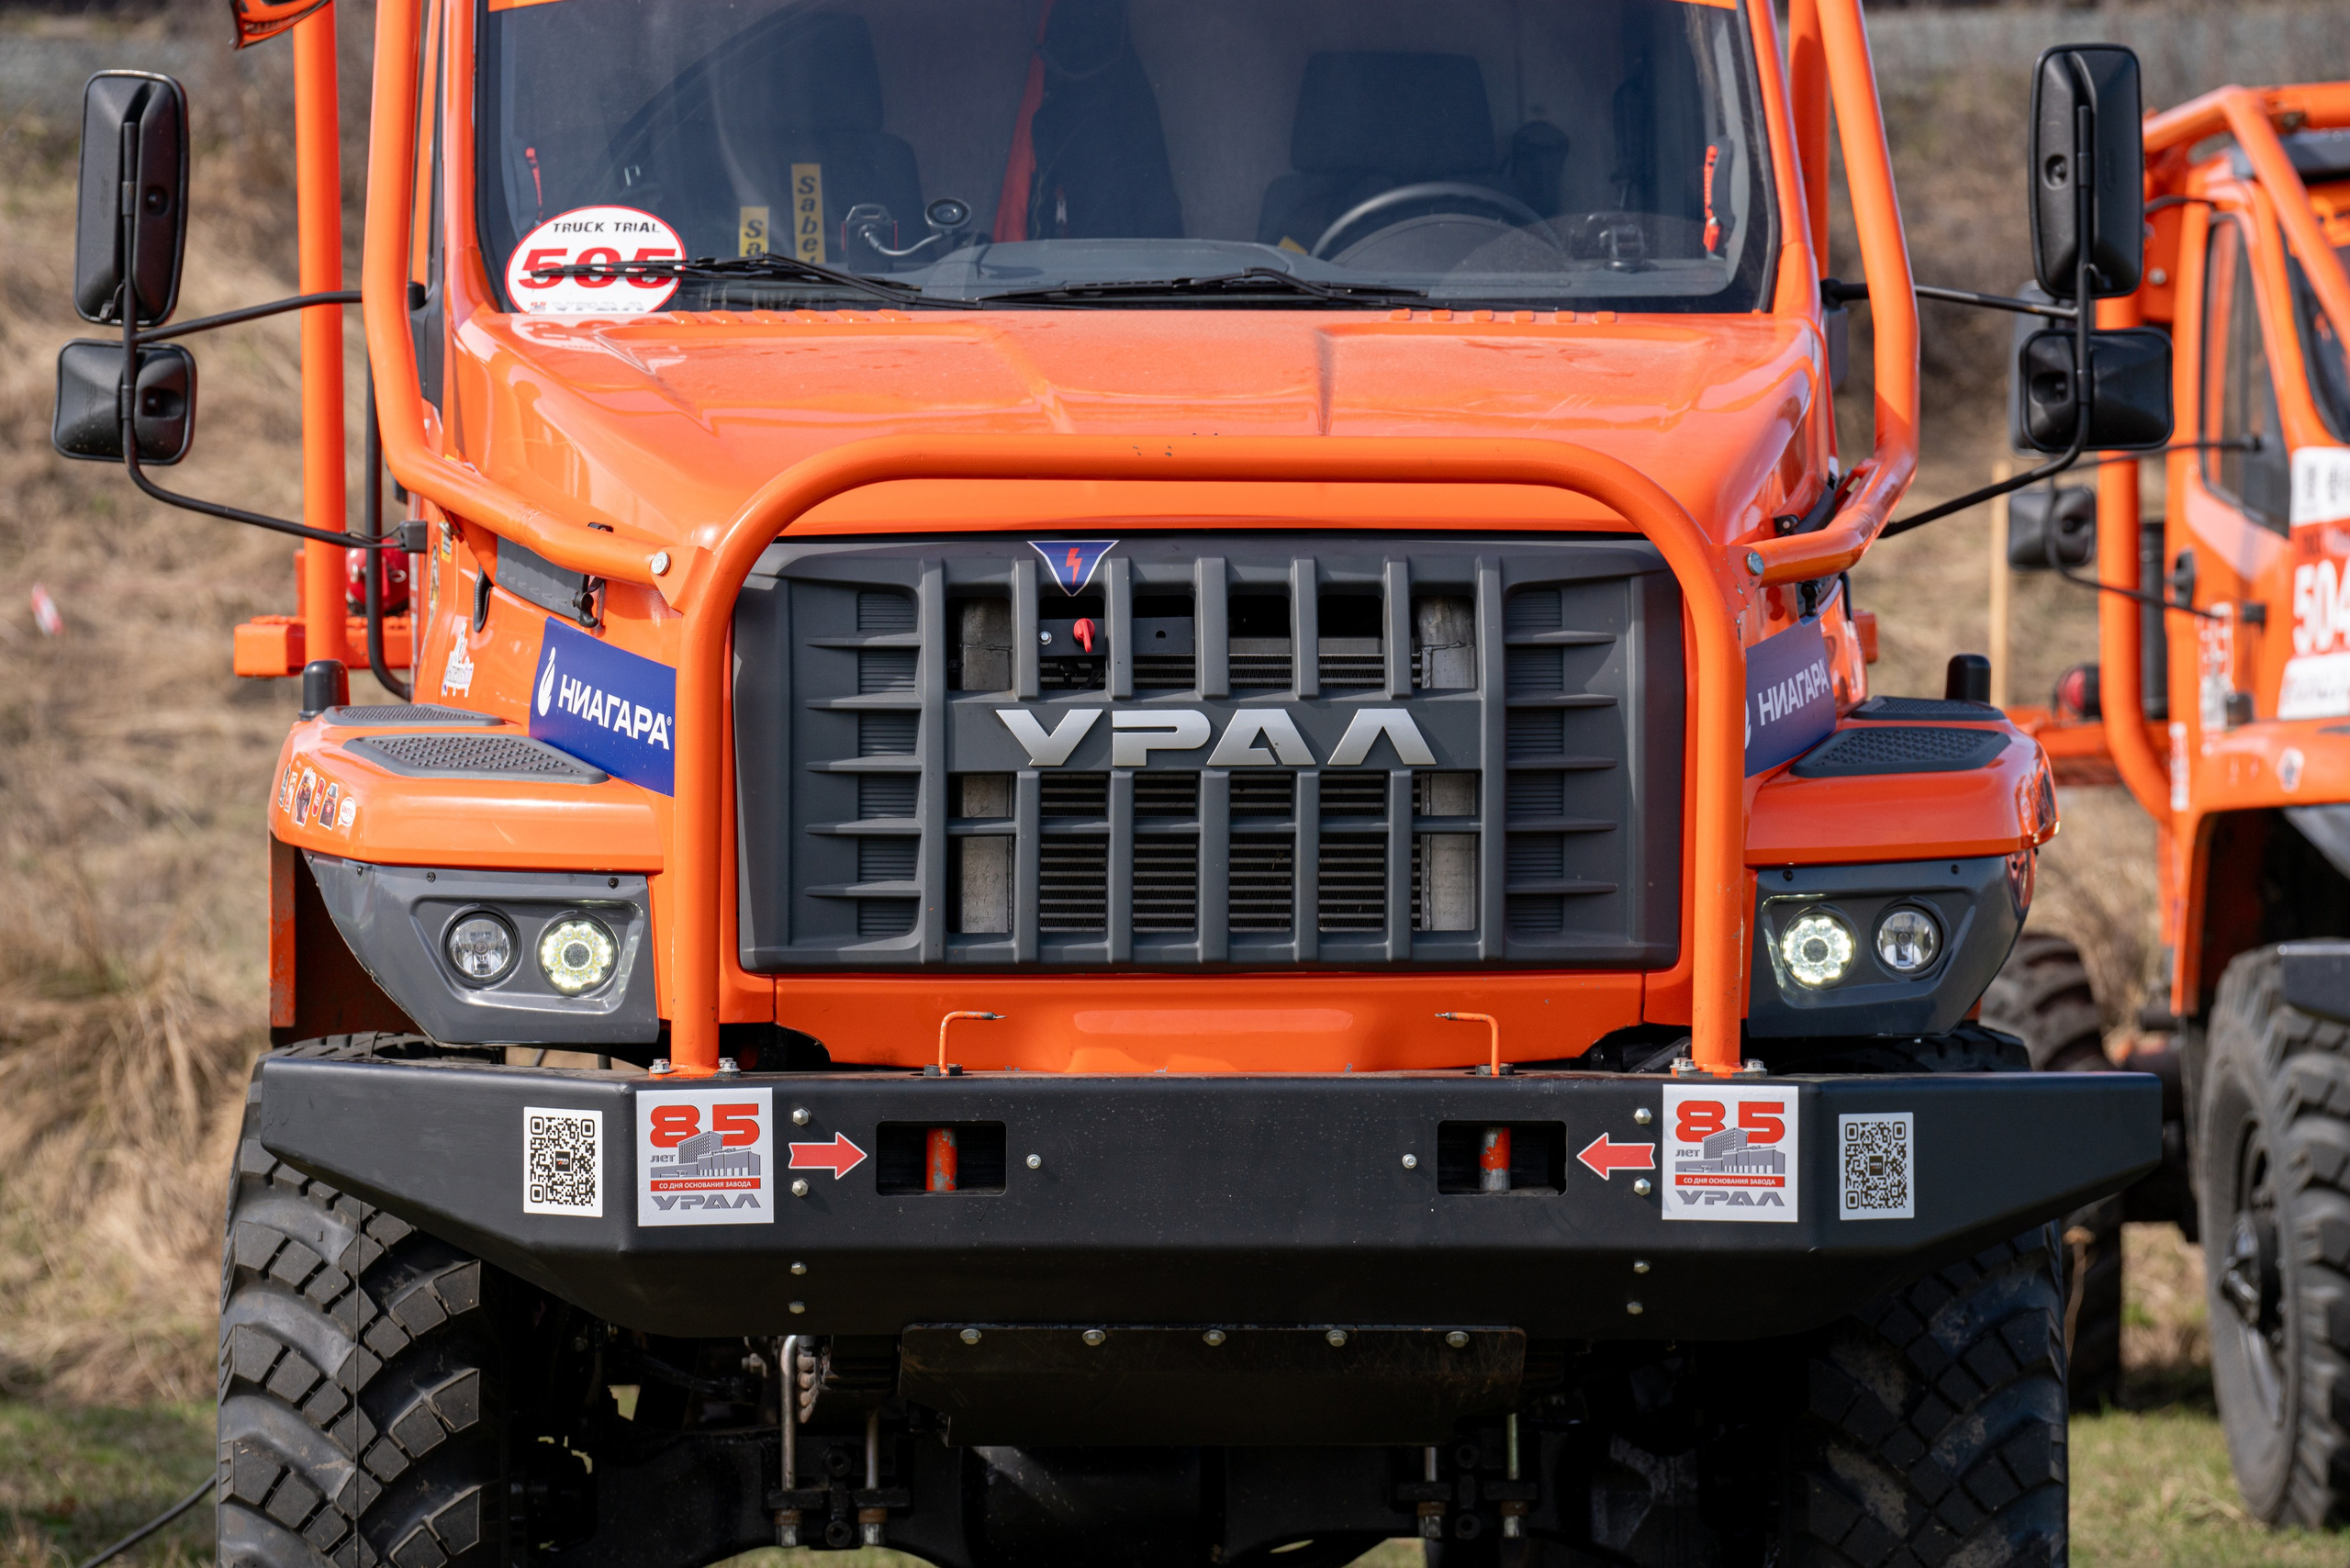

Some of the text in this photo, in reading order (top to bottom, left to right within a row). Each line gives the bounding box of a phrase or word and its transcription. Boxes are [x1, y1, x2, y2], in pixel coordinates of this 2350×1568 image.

[554, 221, 661, 233] TRUCK TRIAL
[518, 247, 677, 289] 505
[1758, 658, 1830, 726] НИАГАРА
[558, 674, 670, 750] НИАГАРА
[995, 709, 1438, 767] УРАЛ
[650, 1103, 760, 1148] 85
[1675, 1100, 1785, 1144] 85
[650, 1154, 676, 1163] лет
[1675, 1148, 1700, 1157] лет
[669, 1182, 683, 1190] ДНЯ
[684, 1181, 724, 1189] ОСНОВАНИЯ
[725, 1180, 752, 1188] ЗАВОДА
[1750, 1178, 1775, 1186] ЗАВОДА
[650, 1193, 761, 1211] УРАЛ
[1675, 1190, 1785, 1207] УРАЛ
